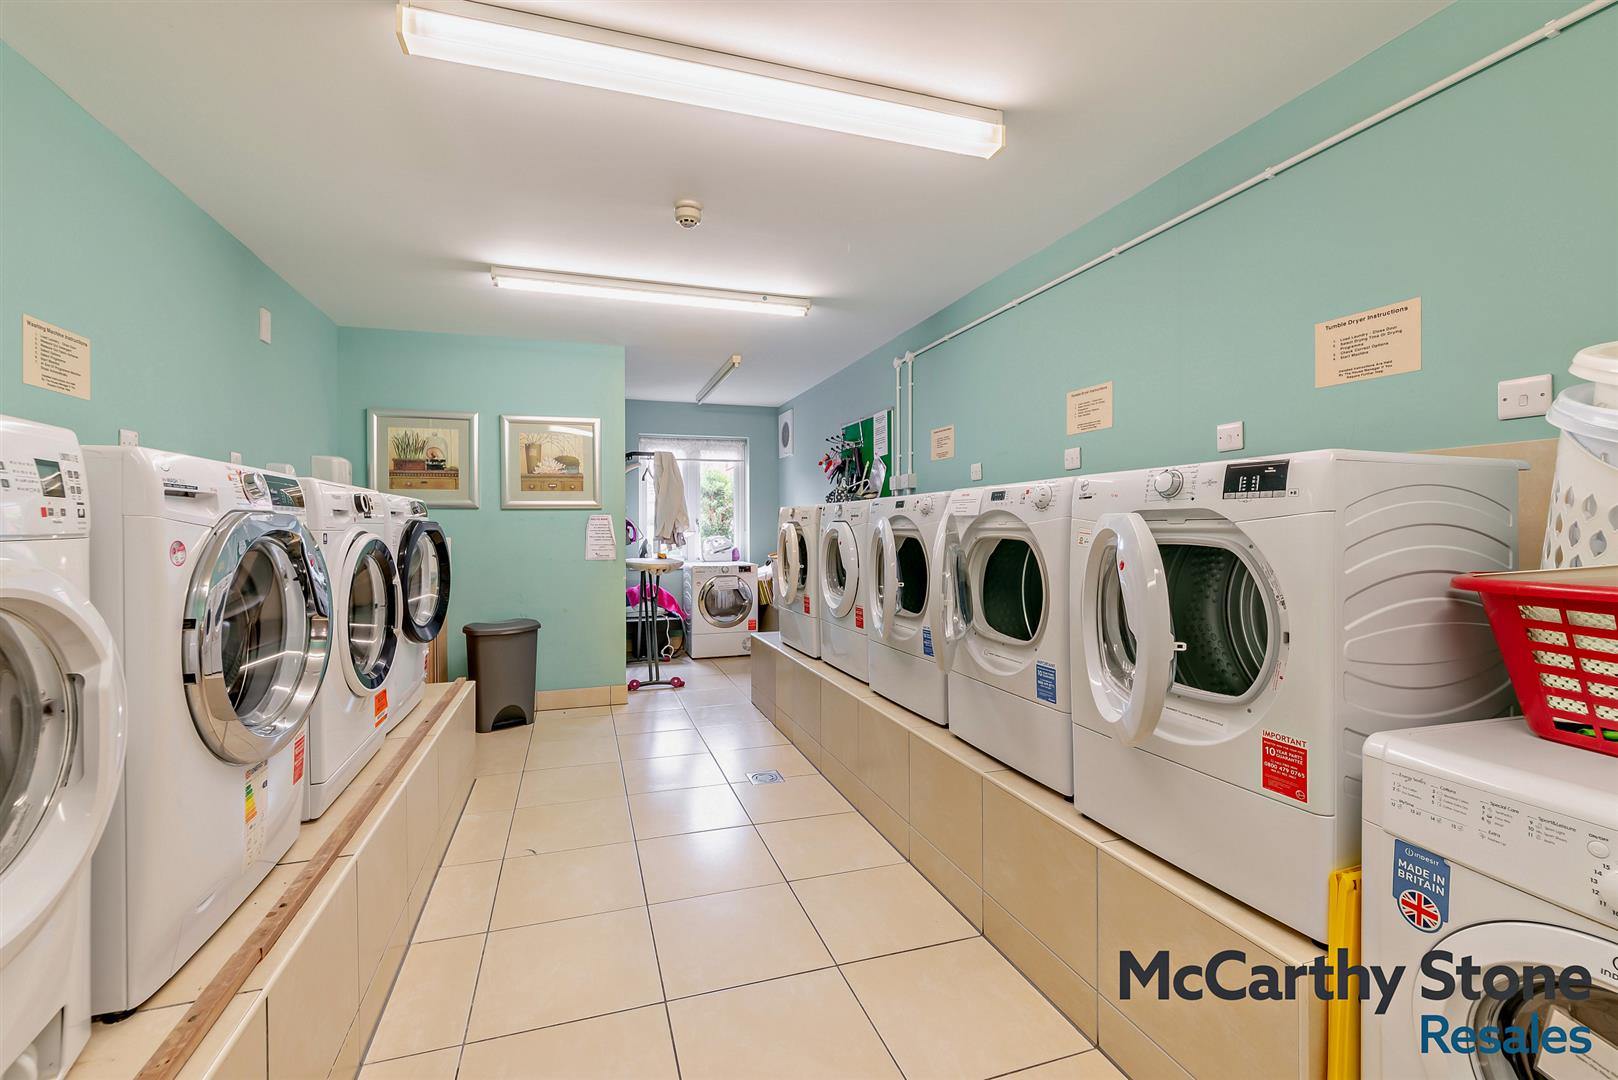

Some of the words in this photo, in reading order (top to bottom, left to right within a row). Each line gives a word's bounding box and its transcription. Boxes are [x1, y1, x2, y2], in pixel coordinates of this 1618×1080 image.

[1325, 320, 1346, 330] Tumble
[1347, 316, 1366, 326] Dryer
[1367, 306, 1408, 320] Instructions
[1262, 730, 1307, 747] IMPORTANT
[1265, 746, 1275, 756] 10
[1288, 752, 1302, 760] PARTS
[1264, 761, 1277, 769] 0800
[1276, 756, 1303, 765] GUARANTEE
[1490, 802, 1507, 811] Special
[1508, 806, 1519, 814] Care
[1488, 830, 1500, 838] Extra
[1398, 858, 1430, 879] MADE
[1433, 873, 1445, 886] IN
[1398, 868, 1444, 896] BRITAIN
